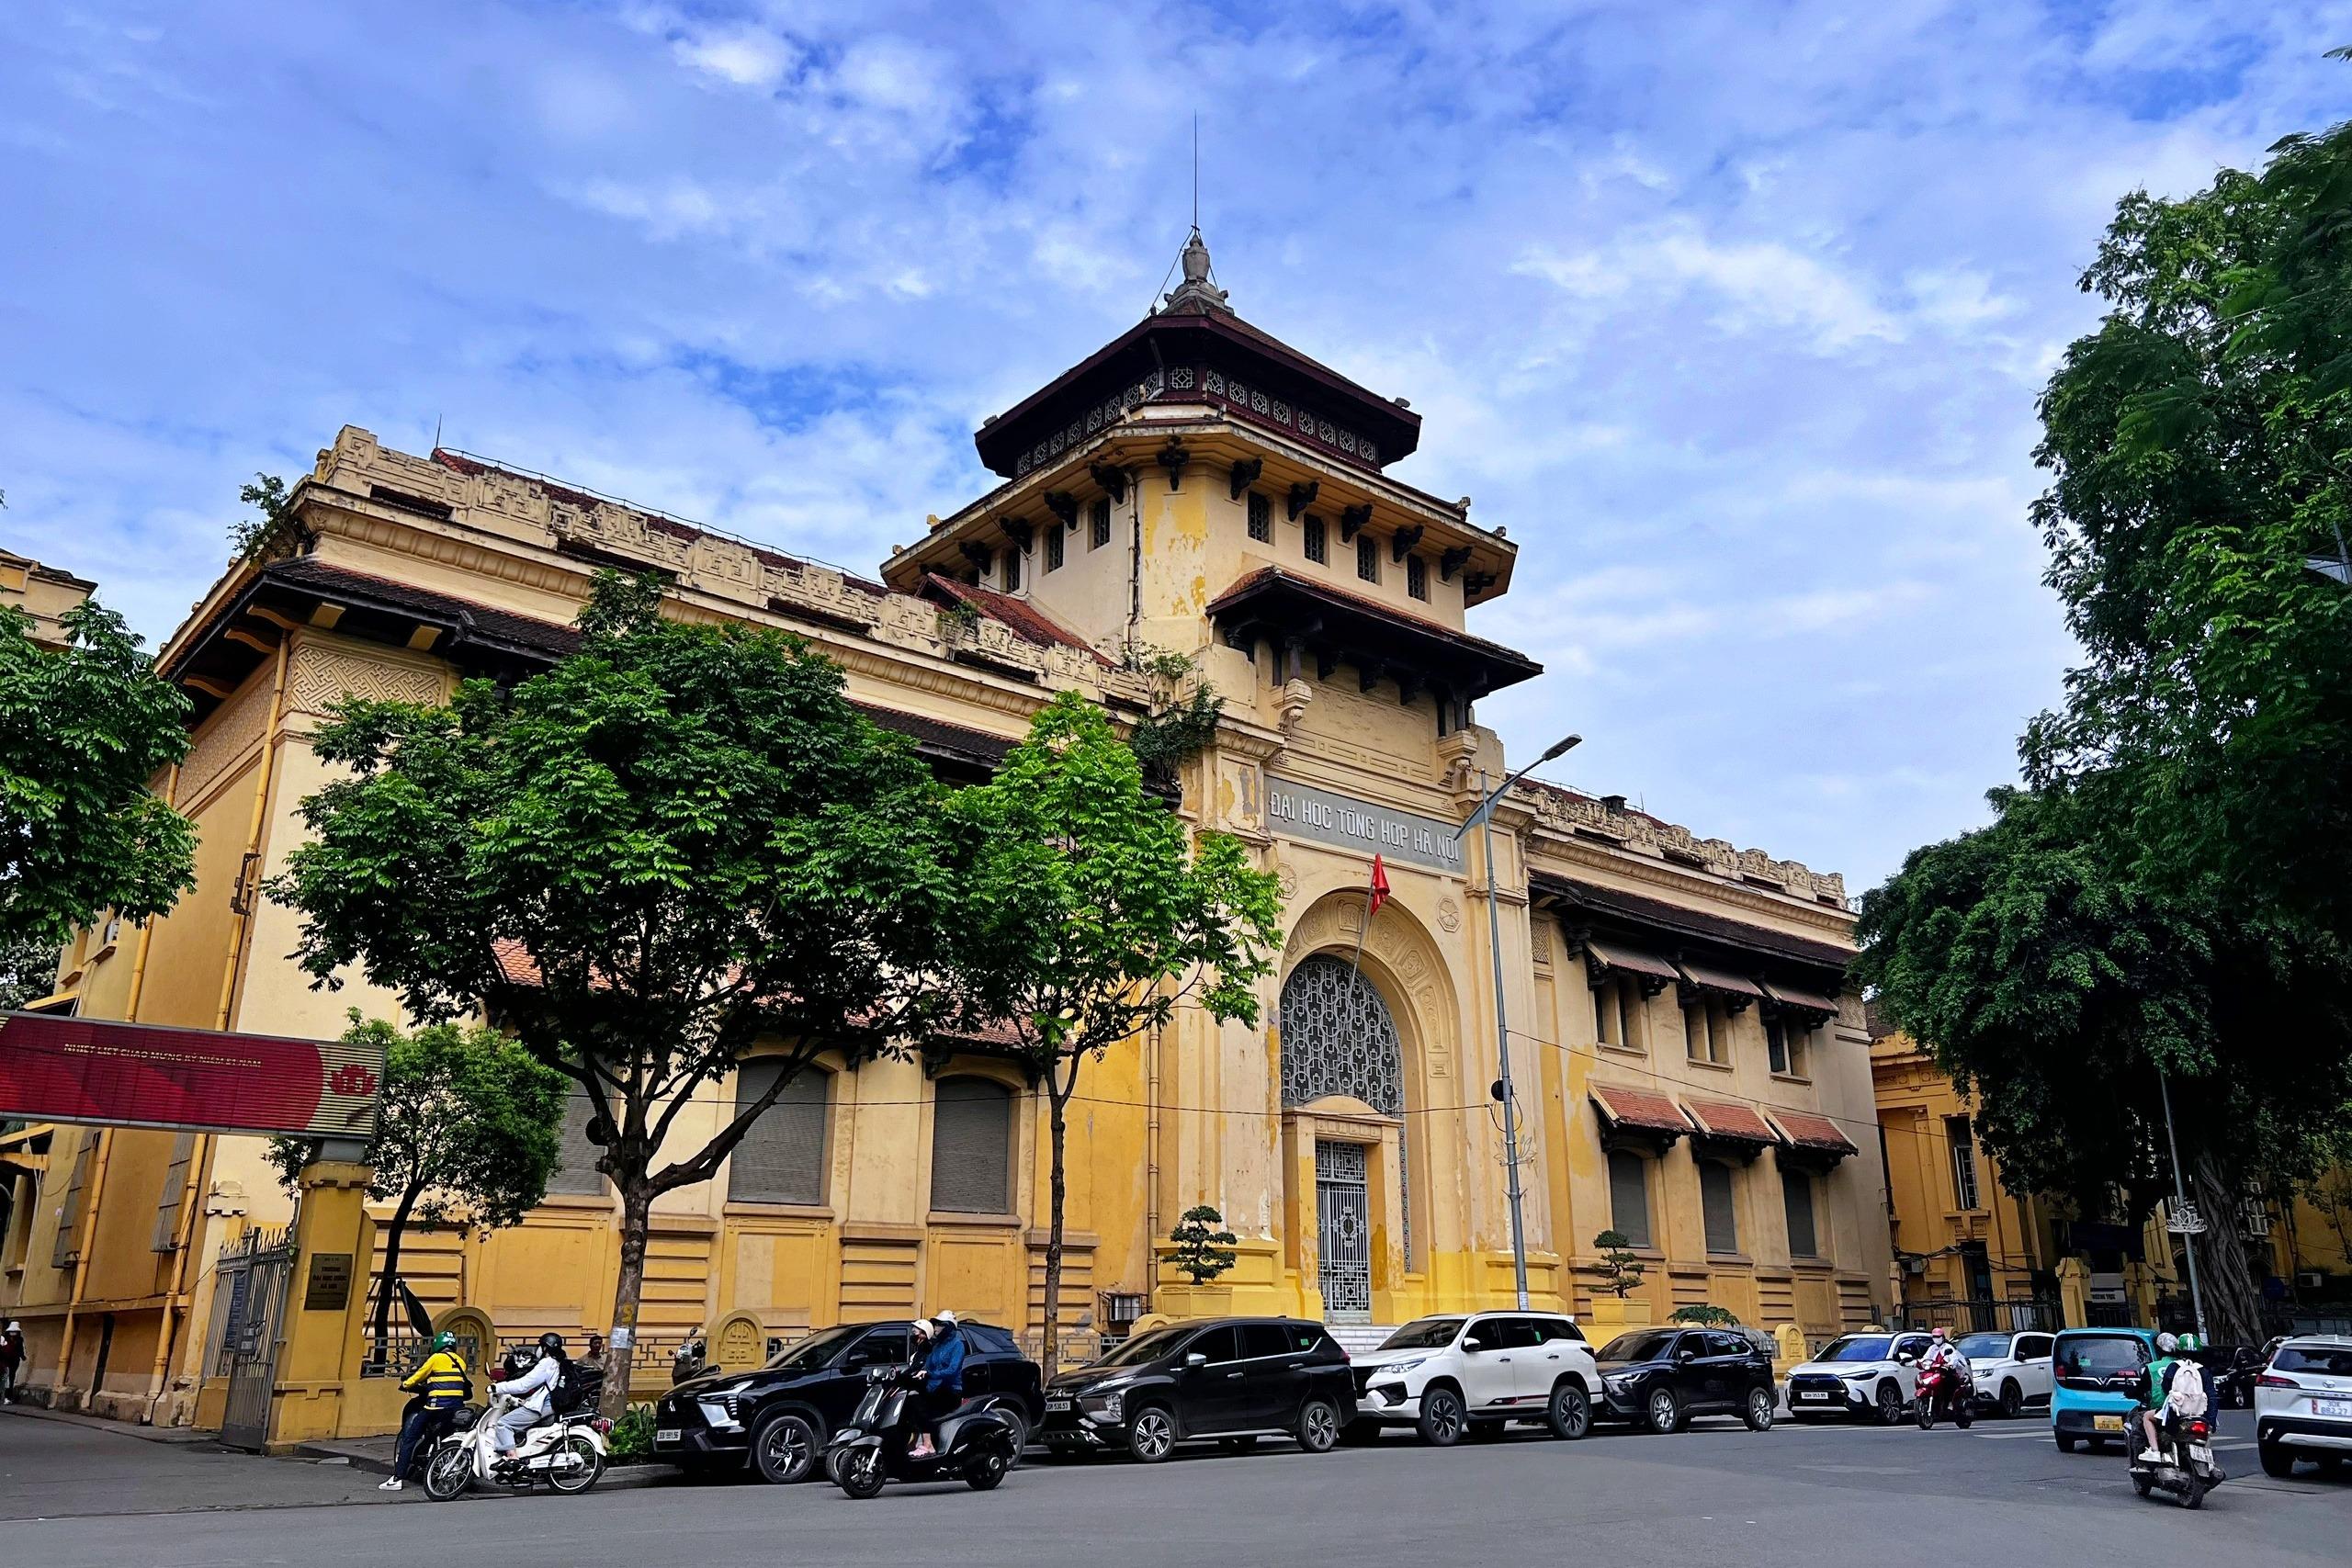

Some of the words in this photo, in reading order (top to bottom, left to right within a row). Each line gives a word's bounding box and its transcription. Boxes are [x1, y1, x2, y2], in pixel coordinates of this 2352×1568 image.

[1269, 791, 1295, 823] ĐẠI
[1301, 797, 1332, 830] HỌC
[1413, 827, 1433, 855] HÀ
[1436, 833, 1459, 863] NỘI
